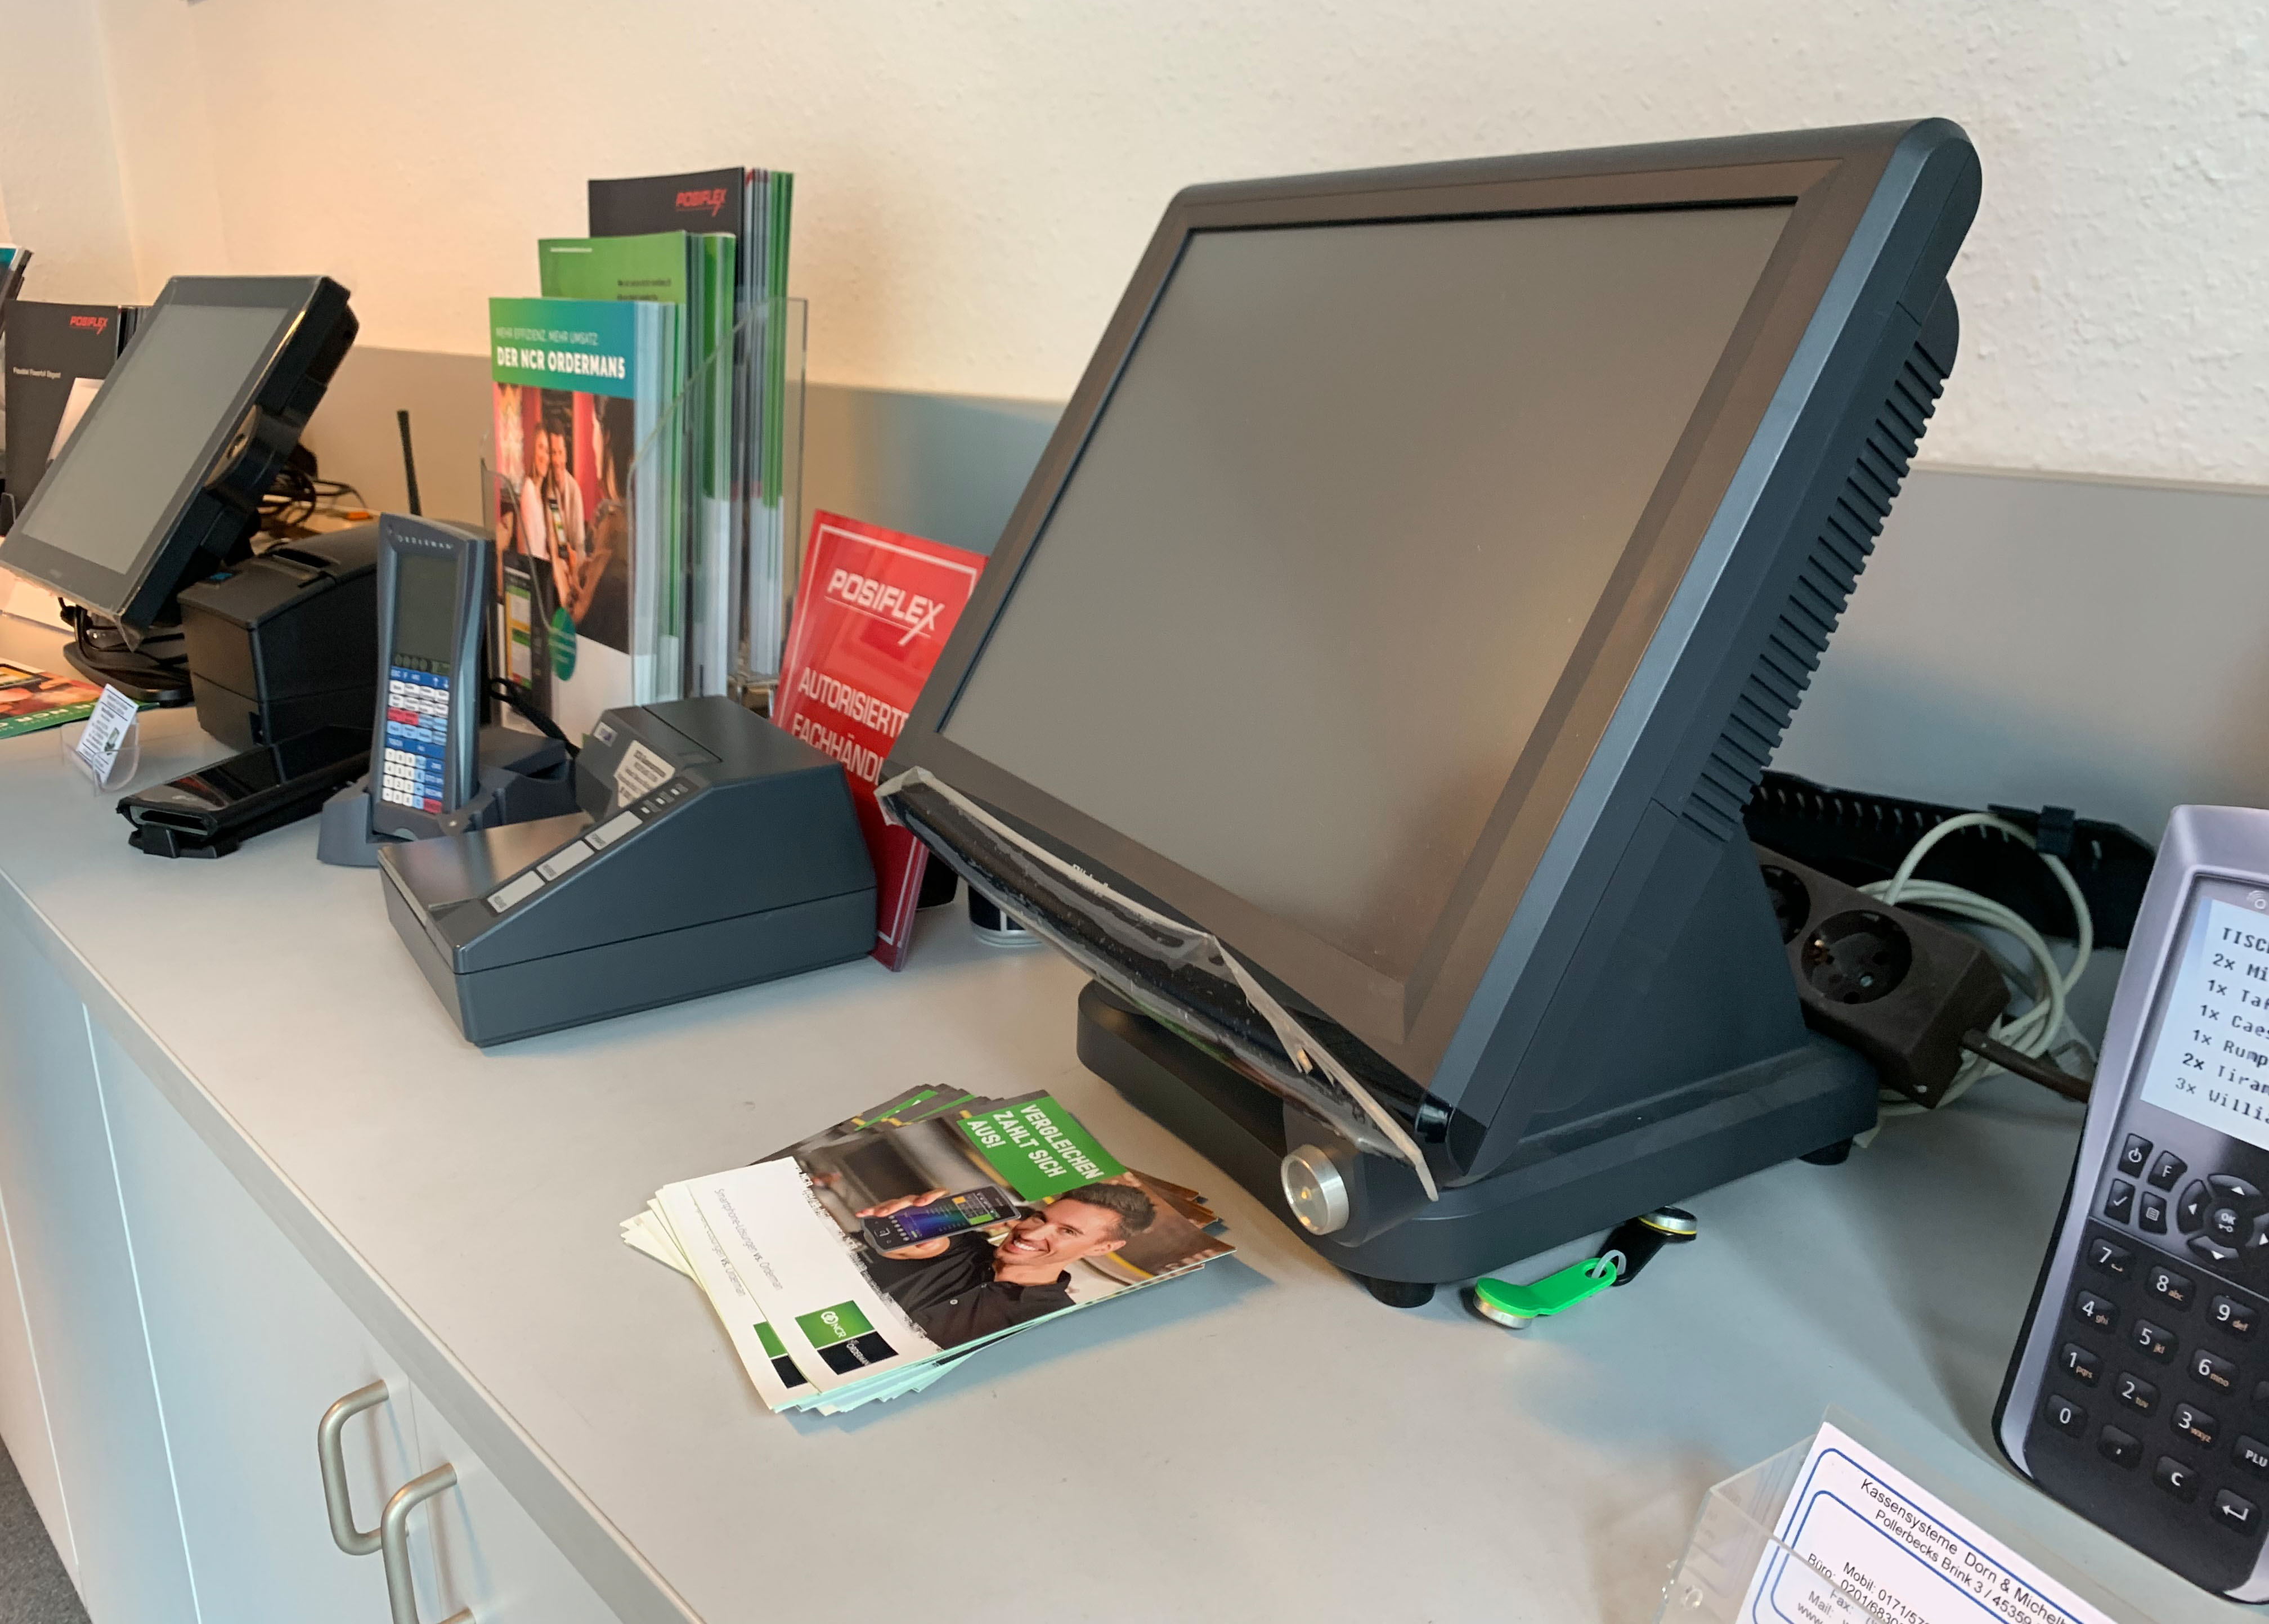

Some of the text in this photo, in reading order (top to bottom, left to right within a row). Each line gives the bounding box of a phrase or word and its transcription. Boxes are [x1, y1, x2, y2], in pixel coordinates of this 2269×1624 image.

[497, 346, 518, 367] DER
[521, 348, 545, 370] NCR
[827, 568, 946, 645] POSIFLEX
[2223, 927, 2269, 954] TISC
[2213, 953, 2235, 970] 2x
[2208, 980, 2227, 995] 1x
[2200, 1004, 2219, 1021] 1x
[2193, 1029, 2268, 1067] 1x Rump
[2182, 1052, 2204, 1070] 2x
[2175, 1077, 2196, 1094] 3x
[967, 1120, 1006, 1148] AUS!
[1020, 1104, 1104, 1179] VERGLEICHEN
[993, 1110, 1067, 1178] ZAHLT SICH
[2162, 1165, 2172, 1178] F
[2221, 1213, 2236, 1225] OK
[2099, 1246, 2112, 1263] 7
[2156, 1275, 2169, 1292] 8
[2082, 1300, 2095, 1317] 4
[2216, 1304, 2230, 1321] 9
[831, 1323, 847, 1339] NCR
[2139, 1327, 2153, 1345] 5
[2069, 1352, 2077, 1367] 1
[2198, 1358, 2212, 1376] 6
[2122, 1380, 2135, 1399] 2
[2178, 1411, 2192, 1429] 3
[2245, 1449, 2268, 1468] PLU
[1860, 1478, 1958, 1555] Kassensysteme
[1964, 1551, 1997, 1583] Dorn
[2000, 1578, 2010, 1593] &
[1875, 1509, 1939, 1562] Pollerbecks
[1941, 1556, 1971, 1587] Brink
[1974, 1581, 1983, 1594] 3
[1841, 1580, 1903, 1624] 0201/6830
[1843, 1562, 1930, 1624] Mobil: 0171/57
[1809, 1591, 1834, 1618] Mail:
